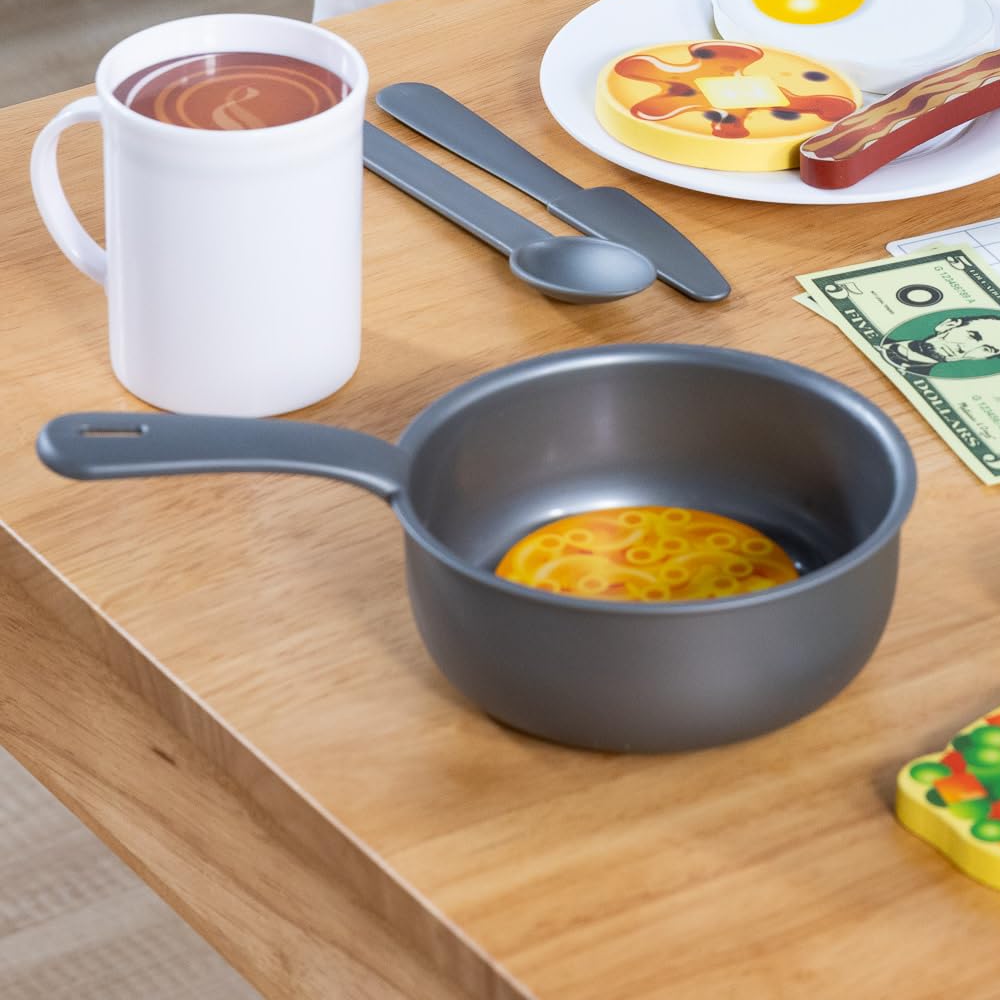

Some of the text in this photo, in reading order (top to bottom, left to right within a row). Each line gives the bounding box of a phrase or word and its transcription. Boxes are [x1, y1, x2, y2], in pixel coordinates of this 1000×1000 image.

[946, 255, 973, 271] 5
[824, 280, 864, 301] 5
[844, 308, 880, 341] FIVE
[912, 377, 982, 450] DOLLARS
